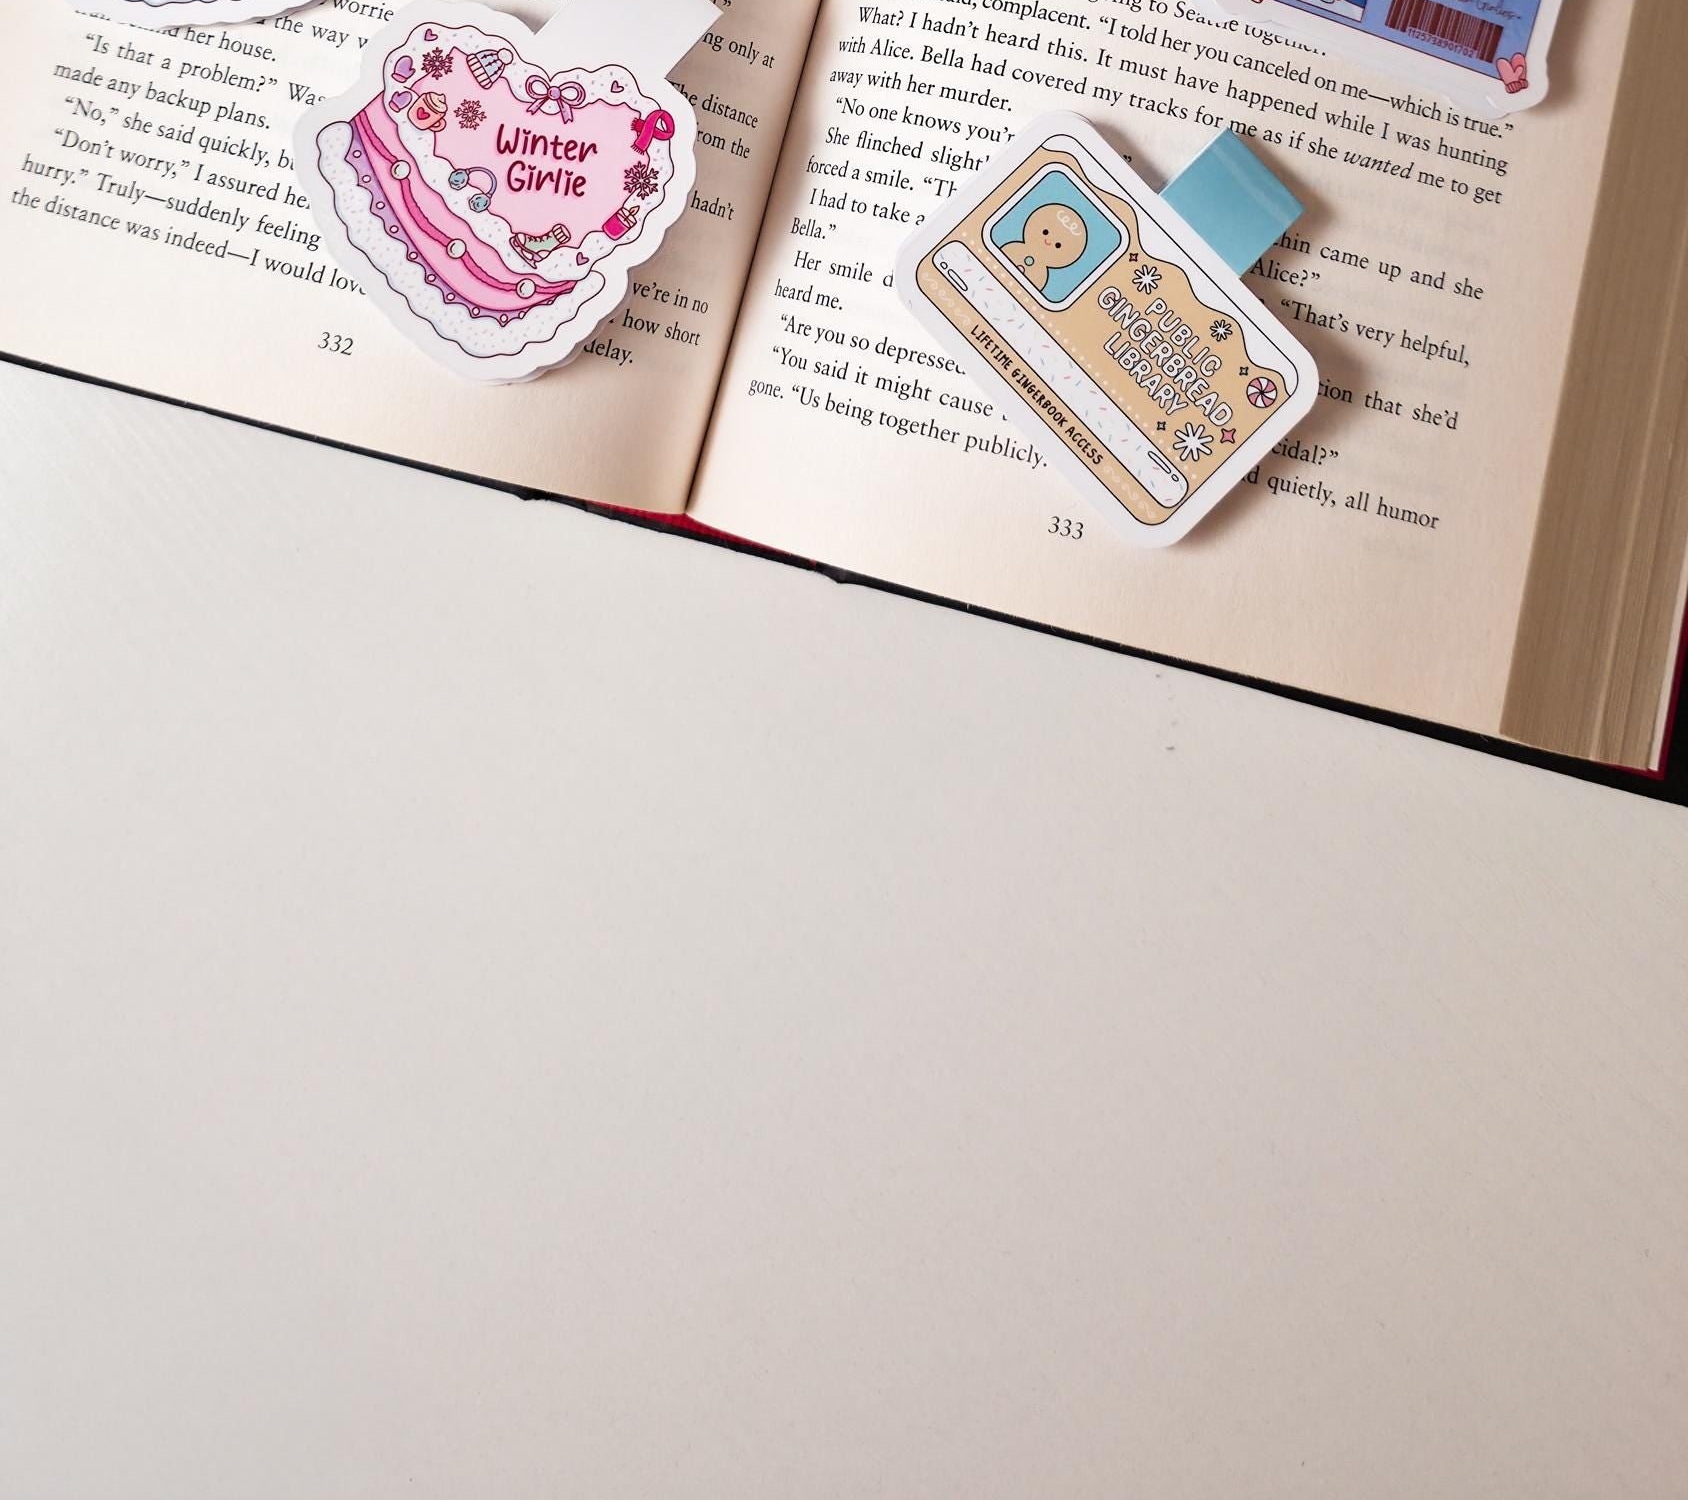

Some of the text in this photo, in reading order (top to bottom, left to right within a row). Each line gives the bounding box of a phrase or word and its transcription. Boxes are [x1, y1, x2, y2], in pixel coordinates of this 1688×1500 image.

[52, 64, 270, 130] made any backup plans.
[839, 35, 1503, 205] with Alice. Bella had covered my tracks for me as if she wanted me to get
[122, 111, 153, 134] she
[156, 124, 196, 145] said
[197, 135, 270, 169] quickly,
[496, 123, 598, 163] Winter
[507, 160, 587, 197] Girlie
[10, 186, 41, 209] the
[44, 195, 121, 231] distance
[126, 221, 161, 241] was
[264, 257, 327, 285] would
[317, 331, 354, 356] 332
[1098, 286, 1234, 426] GINGERBREAD
[1103, 331, 1189, 416] LIBRARY
[1144, 297, 1223, 377] PUBLIC
[747, 379, 784, 400] gone.
[824, 391, 875, 427] being
[878, 411, 961, 444] together
[962, 434, 1048, 470] publicly.
[970, 324, 1104, 465] LIFETIME GINGERBOOK ACCESS
[1047, 515, 1084, 540] 333
[1267, 476, 1440, 530] quietly, all humor
